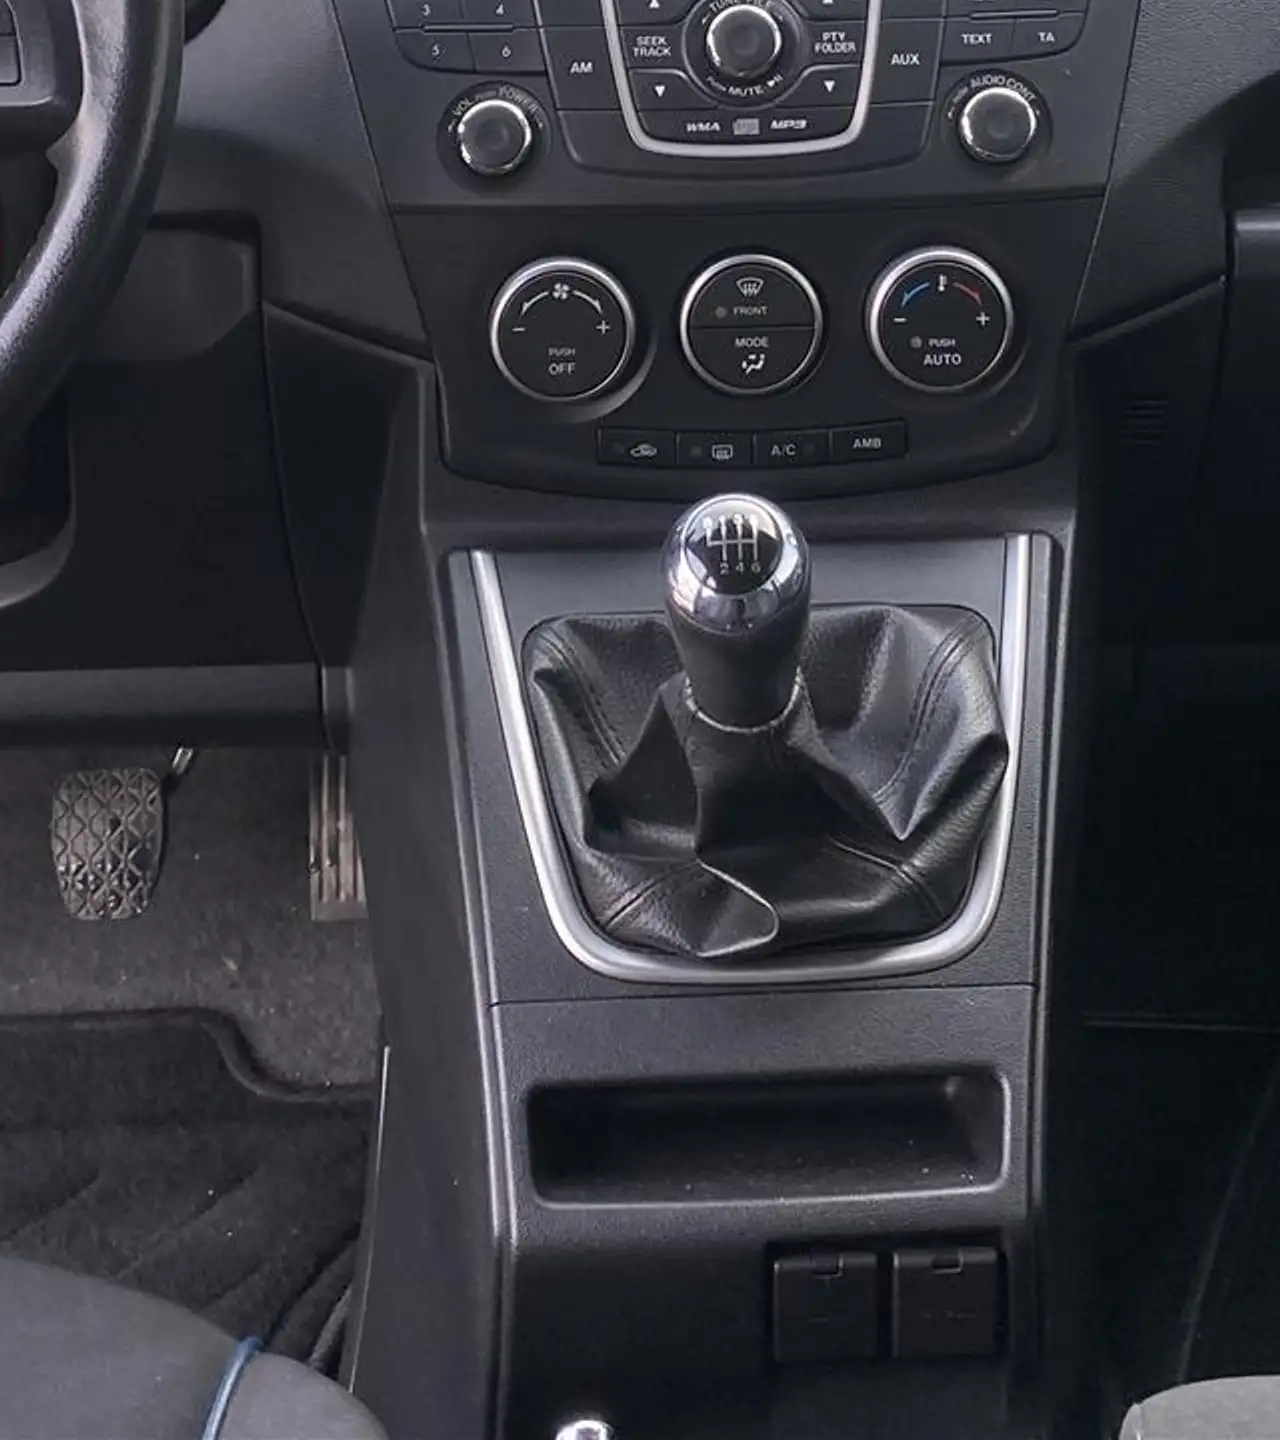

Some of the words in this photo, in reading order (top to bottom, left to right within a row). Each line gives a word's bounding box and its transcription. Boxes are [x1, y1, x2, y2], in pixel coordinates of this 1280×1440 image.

[422, 4, 431, 16] 3
[496, 4, 504, 15] 4
[636, 36, 667, 46] SEEK
[961, 34, 993, 44] TEXT
[1038, 32, 1055, 42] TA
[432, 45, 440, 57] 5
[502, 46, 511, 58] 6
[632, 46, 671, 57] TRACK
[814, 42, 856, 53] FOLDER
[891, 54, 920, 65] AUX
[570, 62, 593, 73] AM
[728, 85, 764, 97] MUTE
[970, 74, 1005, 88] AUDIO
[1006, 78, 1036, 101] CONT
[499, 85, 540, 113] POWER
[452, 97, 473, 116] VOL
[686, 122, 720, 132] WMA
[770, 120, 807, 129] MP3
[733, 306, 768, 316] FRONT
[735, 337, 769, 348] MODE
[928, 338, 956, 347] PUSH
[548, 347, 576, 356] PUSH
[923, 354, 961, 366] AUTO
[548, 362, 576, 375] OFF
[853, 438, 882, 450] AMB
[771, 444, 796, 456] A/C
[720, 563, 729, 575] 2
